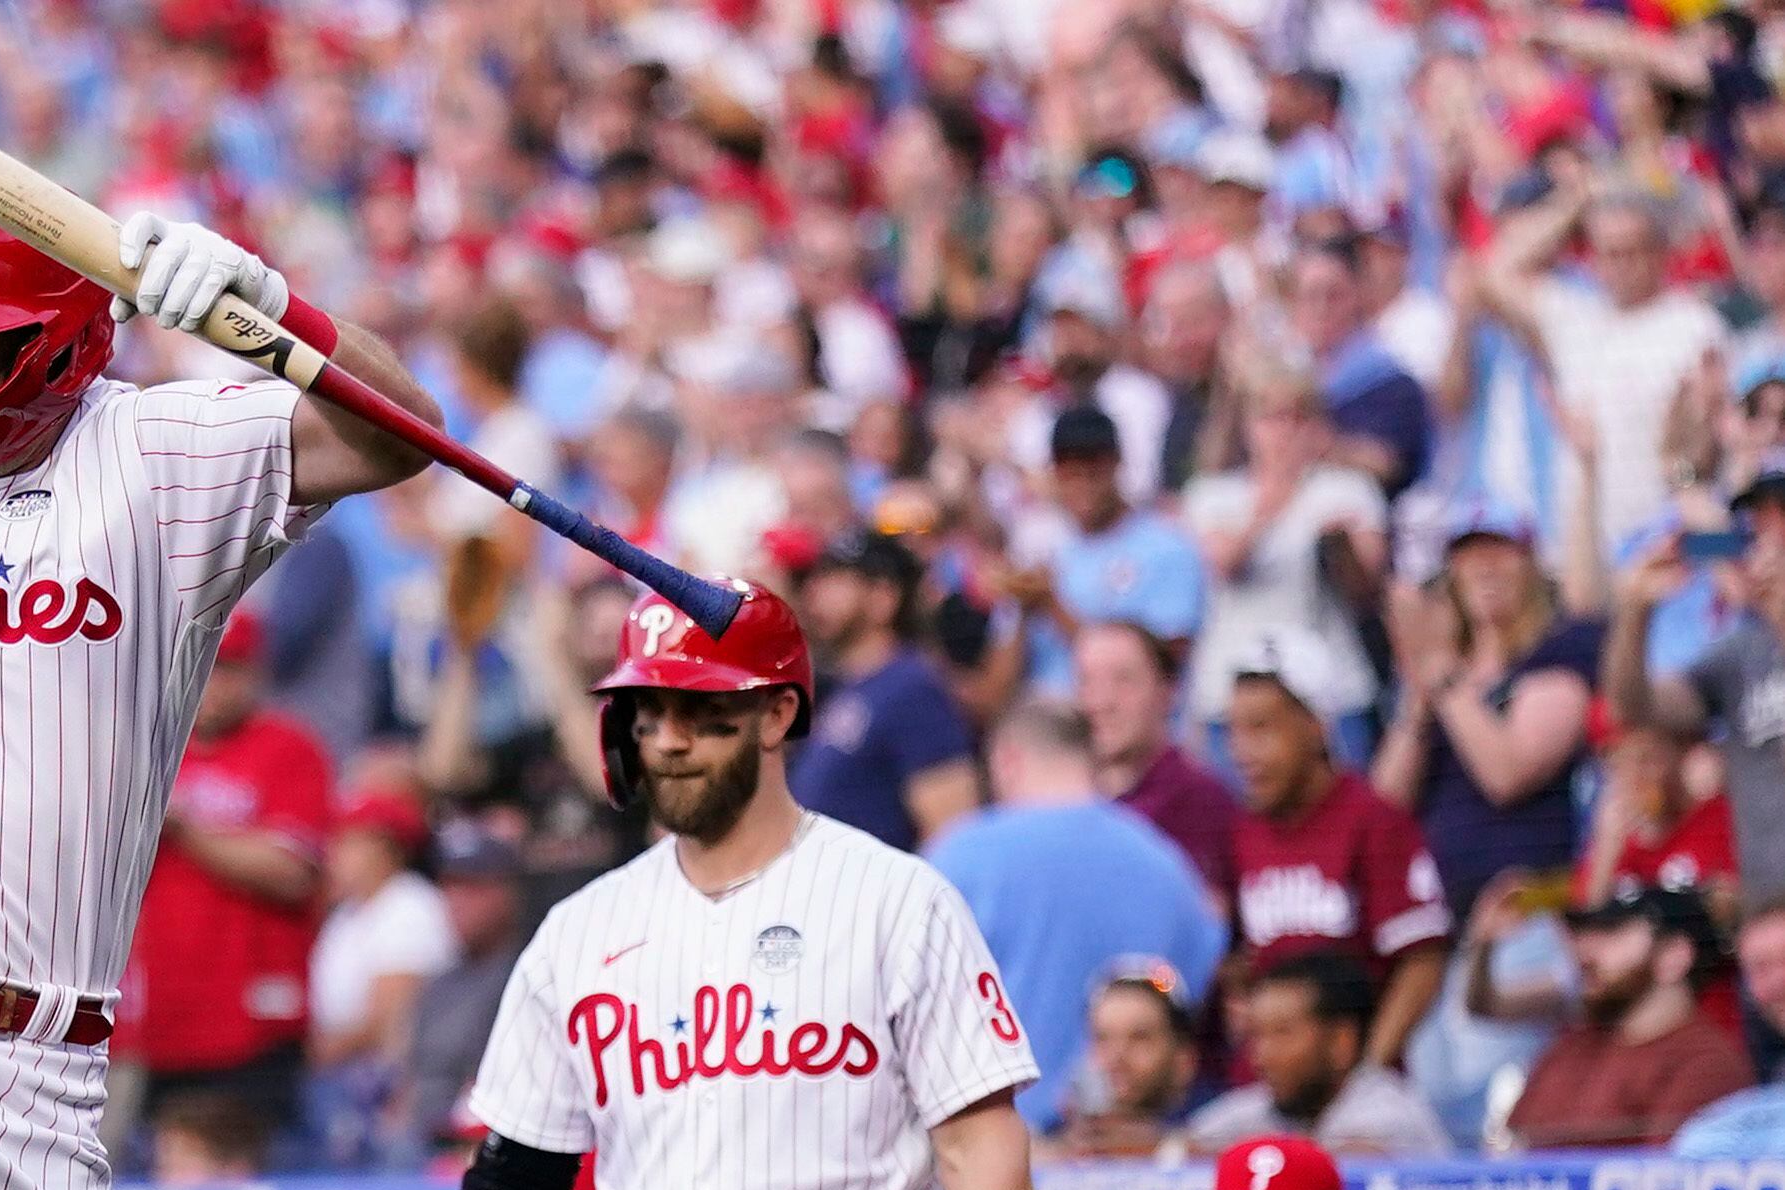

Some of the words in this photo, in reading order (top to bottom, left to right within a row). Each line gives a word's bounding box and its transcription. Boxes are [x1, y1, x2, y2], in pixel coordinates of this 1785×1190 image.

[639, 604, 674, 657] P
[978, 971, 1020, 1042] 3
[568, 983, 879, 1108] Phillies
